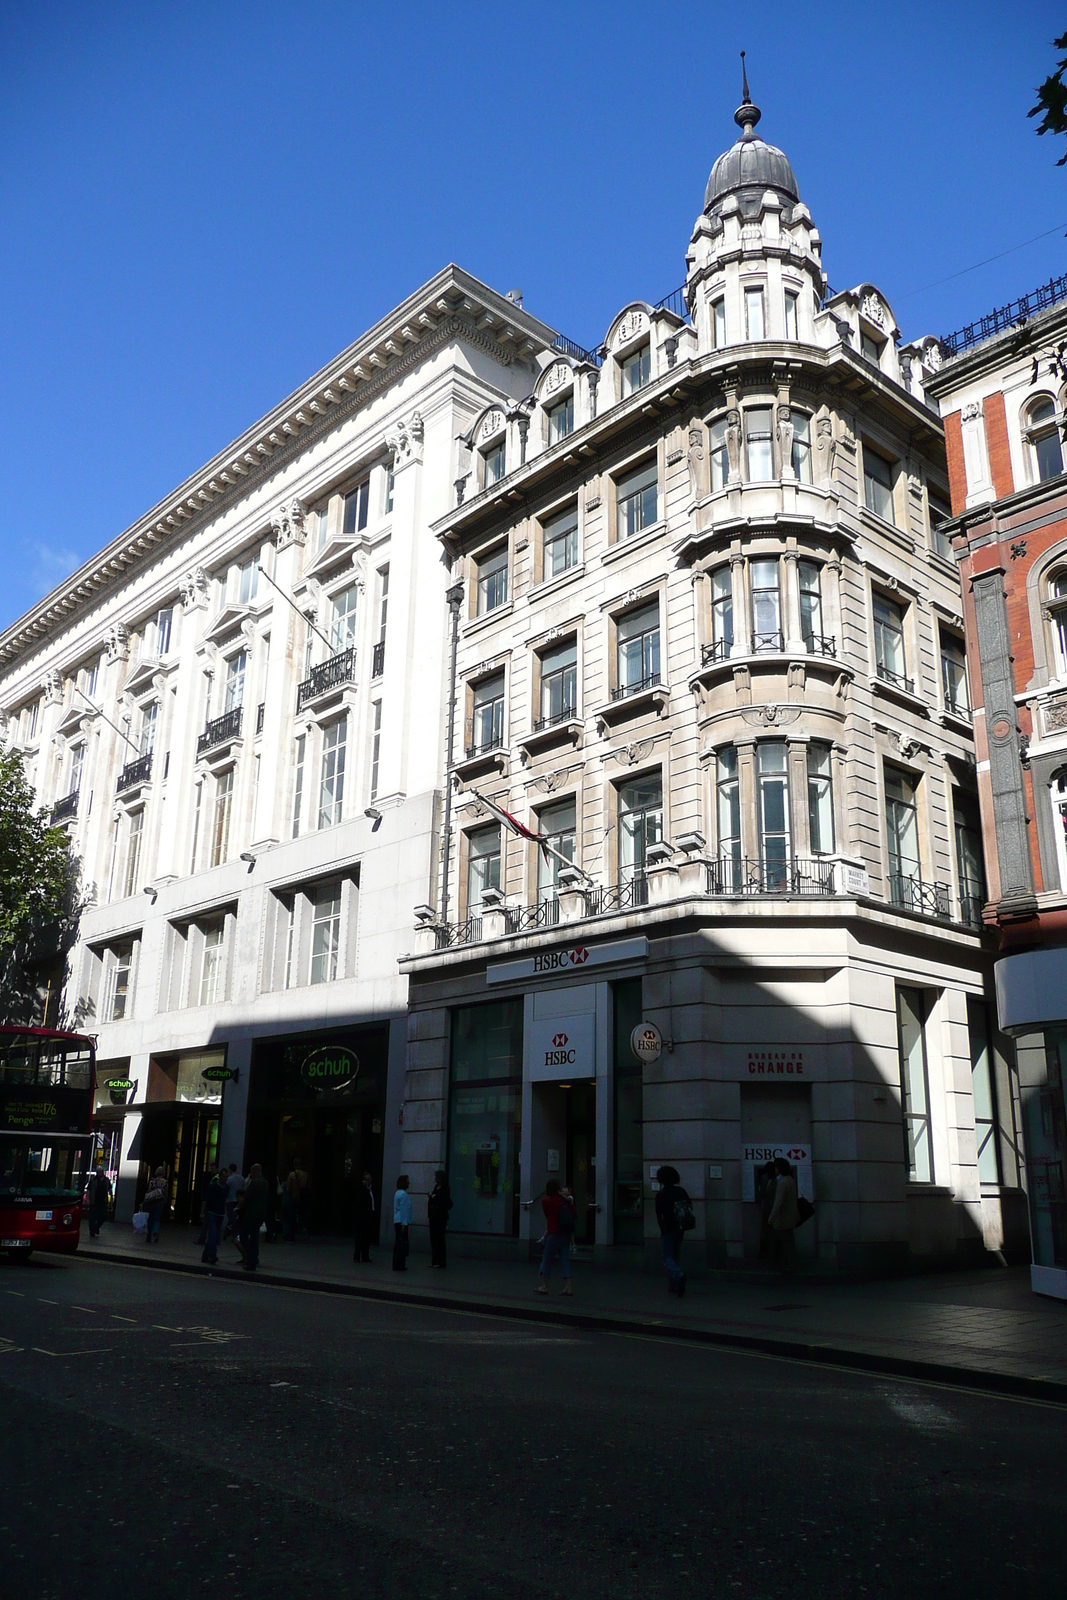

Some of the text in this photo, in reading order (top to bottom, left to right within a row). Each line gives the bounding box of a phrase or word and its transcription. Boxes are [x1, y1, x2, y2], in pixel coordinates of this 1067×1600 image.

[848, 869, 864, 880] MARKET
[848, 877, 861, 886] COURT
[533, 951, 568, 972] HSBC
[637, 1040, 661, 1052] HSBC
[544, 1049, 576, 1066] HSBC
[308, 1055, 351, 1077] schuh
[748, 1061, 803, 1074] CHANGE
[207, 1069, 231, 1077] schuh
[108, 1080, 131, 1088] schuh
[43, 1102, 57, 1115] 176
[8, 1115, 34, 1127] Penge
[744, 1148, 783, 1161] HSBC
